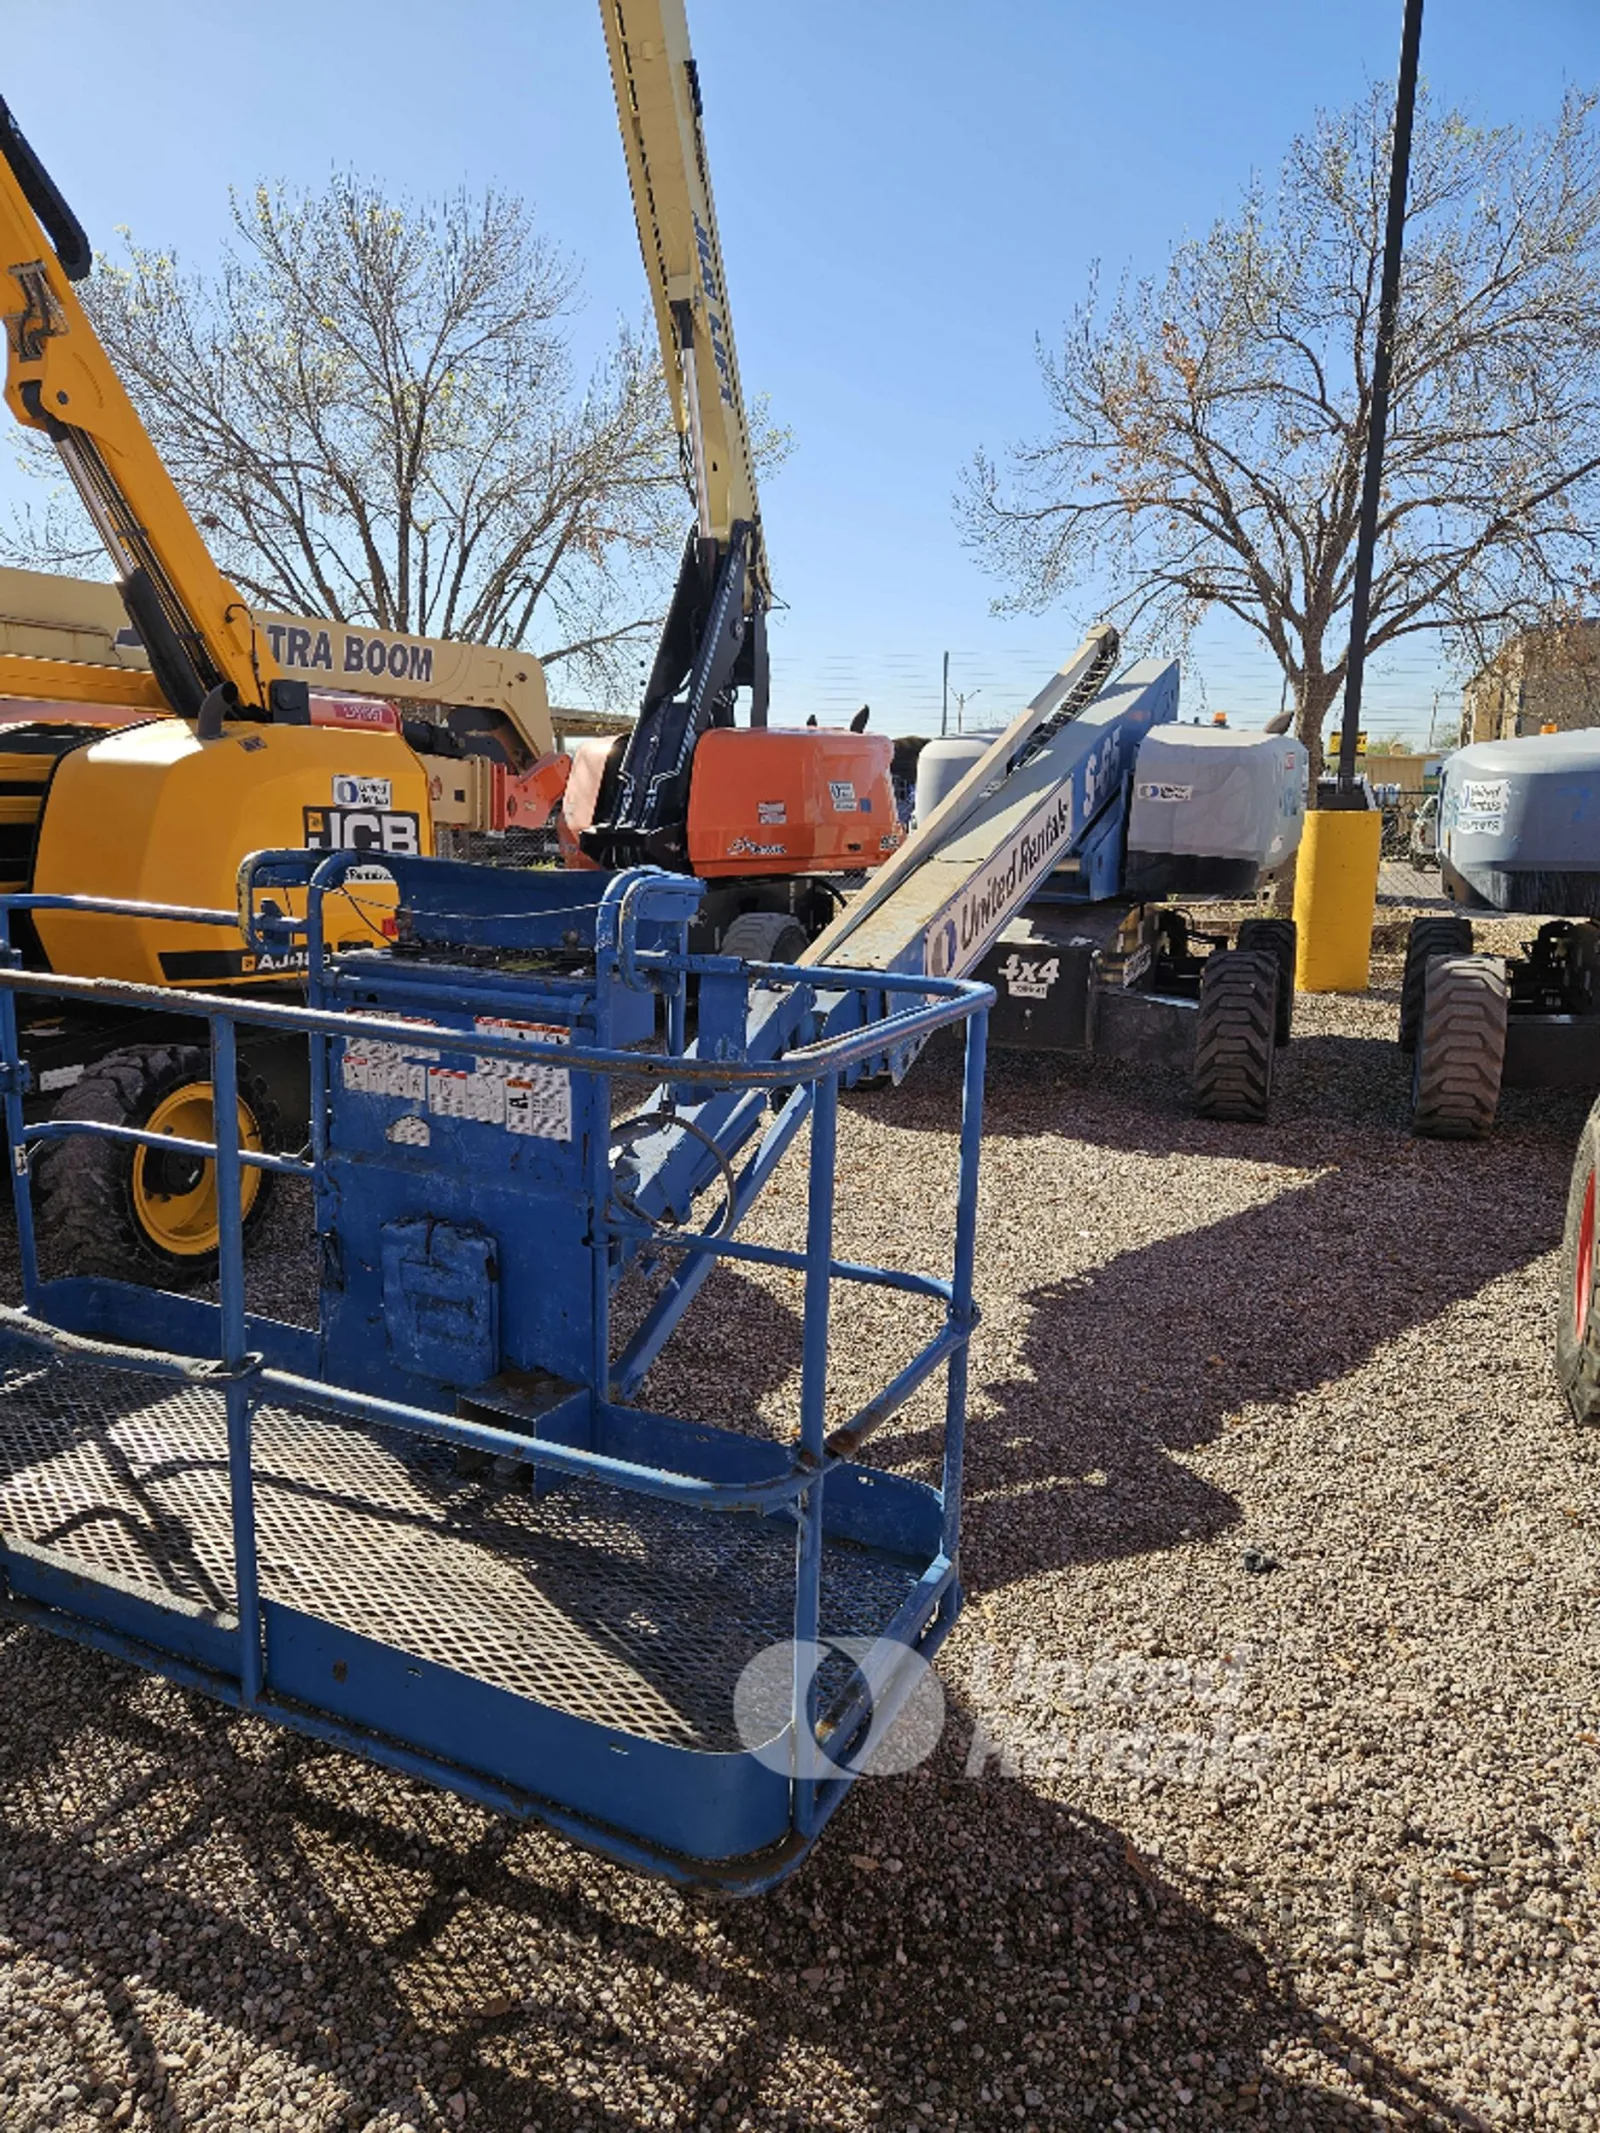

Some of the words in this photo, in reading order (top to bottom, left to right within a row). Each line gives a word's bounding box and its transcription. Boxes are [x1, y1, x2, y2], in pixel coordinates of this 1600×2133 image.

[343, 635, 433, 682] BOOM
[308, 812, 418, 855] JCB
[961, 845, 1017, 950] United
[1018, 797, 1069, 883] Rentals
[998, 954, 1060, 984] 4x4
